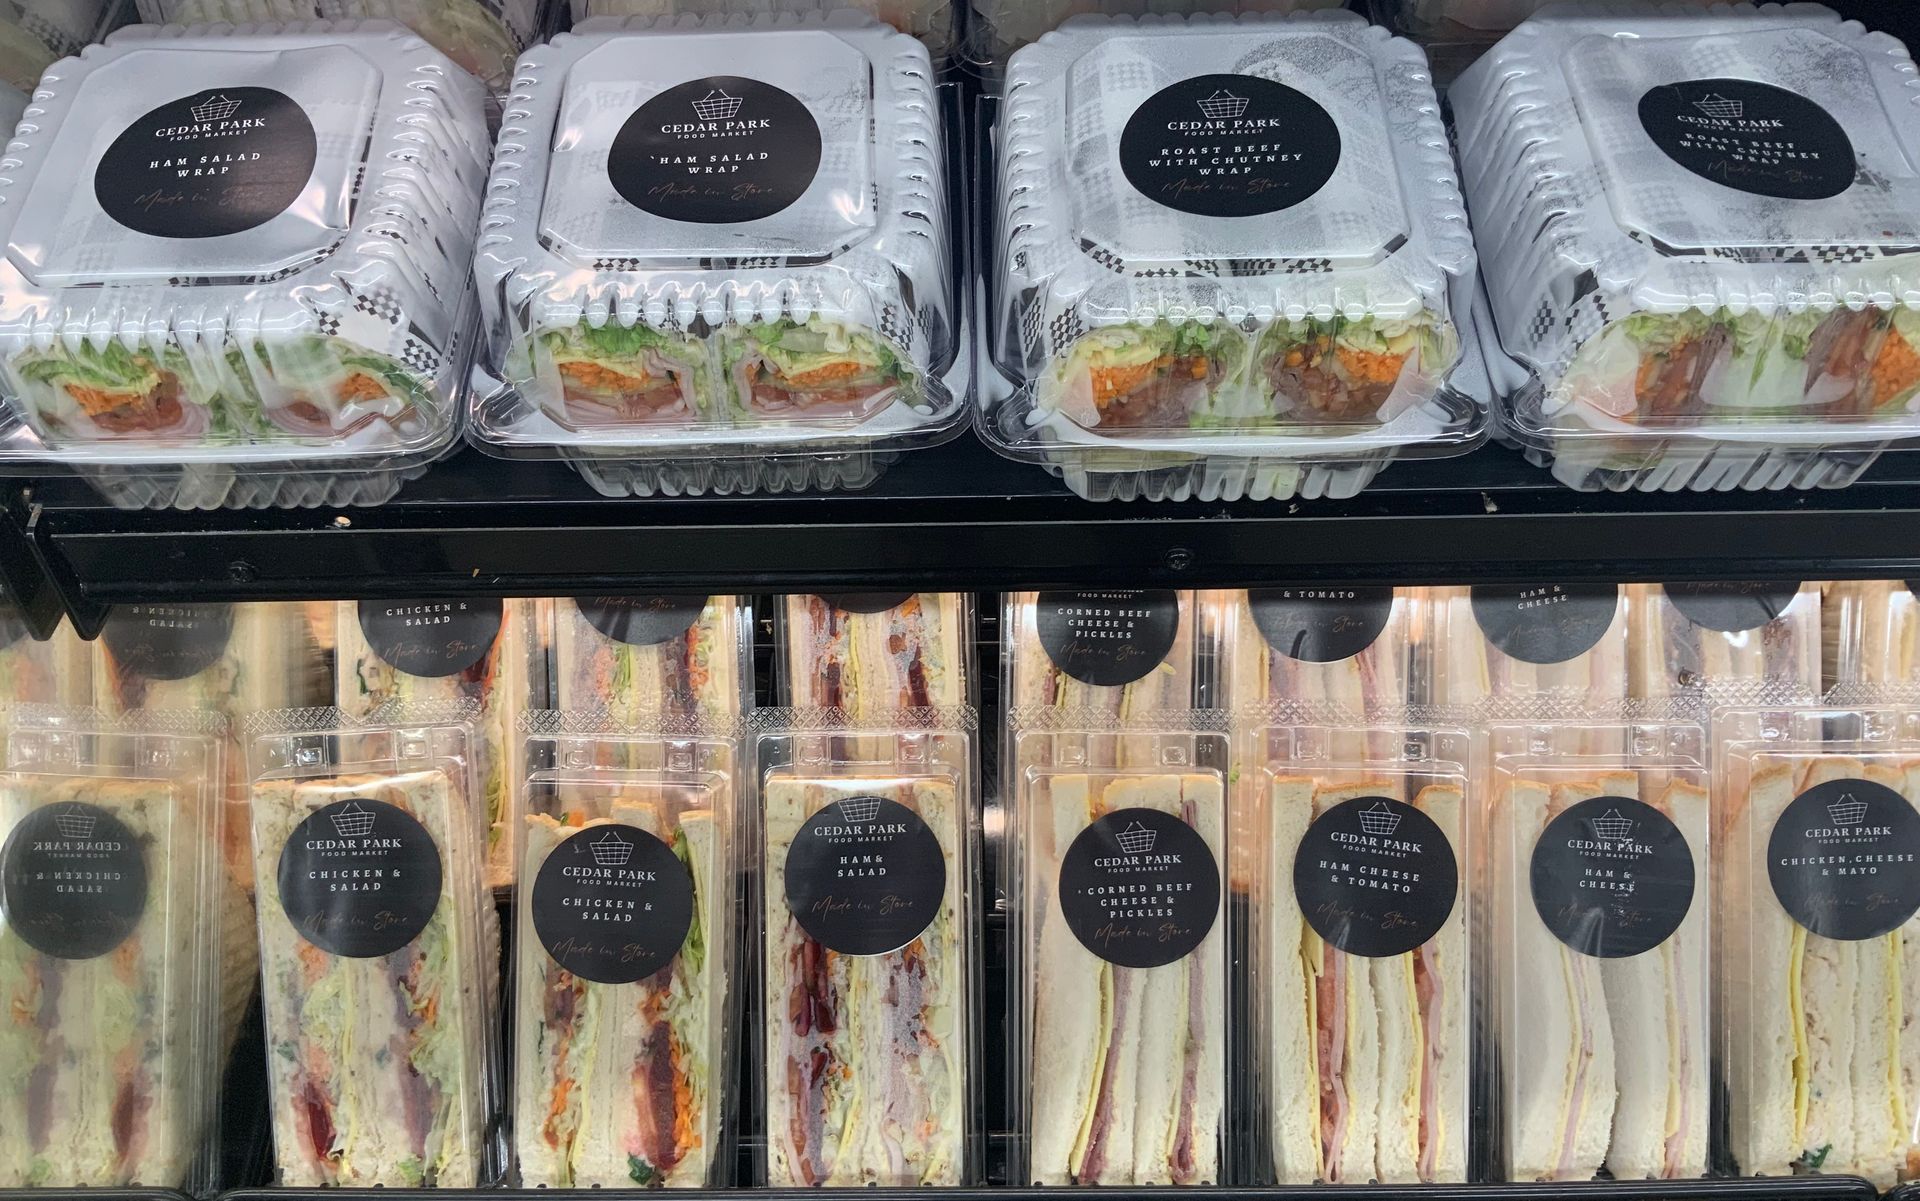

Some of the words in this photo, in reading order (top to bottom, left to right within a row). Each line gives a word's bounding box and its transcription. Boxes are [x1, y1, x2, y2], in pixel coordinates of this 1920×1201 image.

[1168, 120, 1225, 130] CEDAR
[1234, 119, 1280, 128] PARK
[1677, 115, 1732, 126] CEDAR
[155, 123, 212, 137] CEDAR
[220, 118, 266, 130] PARK
[661, 122, 718, 134] CEDAR
[726, 119, 770, 130] PARK
[205, 129, 248, 138] MARKET
[712, 130, 754, 138] MARKET
[1685, 133, 1739, 145] ROAST
[1752, 141, 1794, 149] BEEF
[1161, 147, 1221, 156] ROAST
[1234, 144, 1282, 153] BEEF
[1680, 140, 1726, 151] WITH
[1737, 147, 1819, 159] CHUTNEY
[150, 158, 187, 168] HAM
[200, 152, 261, 164] SALAD
[710, 152, 769, 163] SALAD
[1149, 158, 1198, 167] WITH
[1212, 153, 1302, 164] CHUTNEY
[1732, 154, 1779, 164] WRAP
[177, 166, 229, 177] WRAP
[688, 165, 739, 174] WRAP
[1200, 167, 1251, 176] WRAP
[1284, 590, 1291, 598] &
[1299, 591, 1355, 599] TOMATO
[1520, 588, 1545, 599] HAM
[1518, 594, 1567, 610] CHEESE
[386, 603, 451, 616] CHICKEN
[1057, 608, 1111, 616] CORNED
[1119, 609, 1151, 618] BEEF
[406, 616, 450, 626] SALAD
[1068, 620, 1119, 628] CHEESE
[1075, 631, 1132, 639] PICKLES
[814, 826, 862, 836] CEDAR
[869, 823, 907, 834] PARK
[1805, 828, 1849, 838] CEDAR
[1855, 826, 1892, 835] PARK
[306, 839, 356, 850] CEDAR
[363, 838, 402, 848] PARK
[1331, 832, 1377, 846] CEDAR
[1384, 839, 1422, 853] PARK
[1567, 839, 1612, 851] CEDAR
[1617, 843, 1653, 854] PARK
[1342, 844, 1366, 852] FOOD
[1371, 849, 1406, 858] MARKET
[1094, 856, 1139, 867] CEDAR
[1146, 855, 1182, 864] PARK
[309, 869, 383, 879] CHICKEN
[393, 869, 401, 877] &
[563, 866, 612, 878] CEDAR
[618, 870, 656, 881] PARK
[838, 867, 886, 877] SALAD
[1320, 860, 1349, 872] HAM
[1359, 866, 1420, 882] CHEESE
[1585, 868, 1614, 877] HAM
[1623, 871, 1631, 879] &
[1822, 868, 1829, 876] &
[1838, 867, 1877, 875] MAYO
[331, 882, 381, 892] SALAD
[607, 880, 642, 888] MARKET
[1087, 885, 1146, 895] CORNED
[1156, 883, 1192, 892] BEEF
[1331, 874, 1339, 883] &
[1349, 877, 1410, 893] TOMATO
[1579, 880, 1635, 891] CHEESE
[563, 898, 635, 909] CHICKEN
[645, 903, 652, 911] &
[1101, 897, 1157, 906] CHEESE
[1167, 896, 1174, 904] &
[583, 912, 632, 922] SALAD
[1110, 909, 1172, 918] PICKLES
